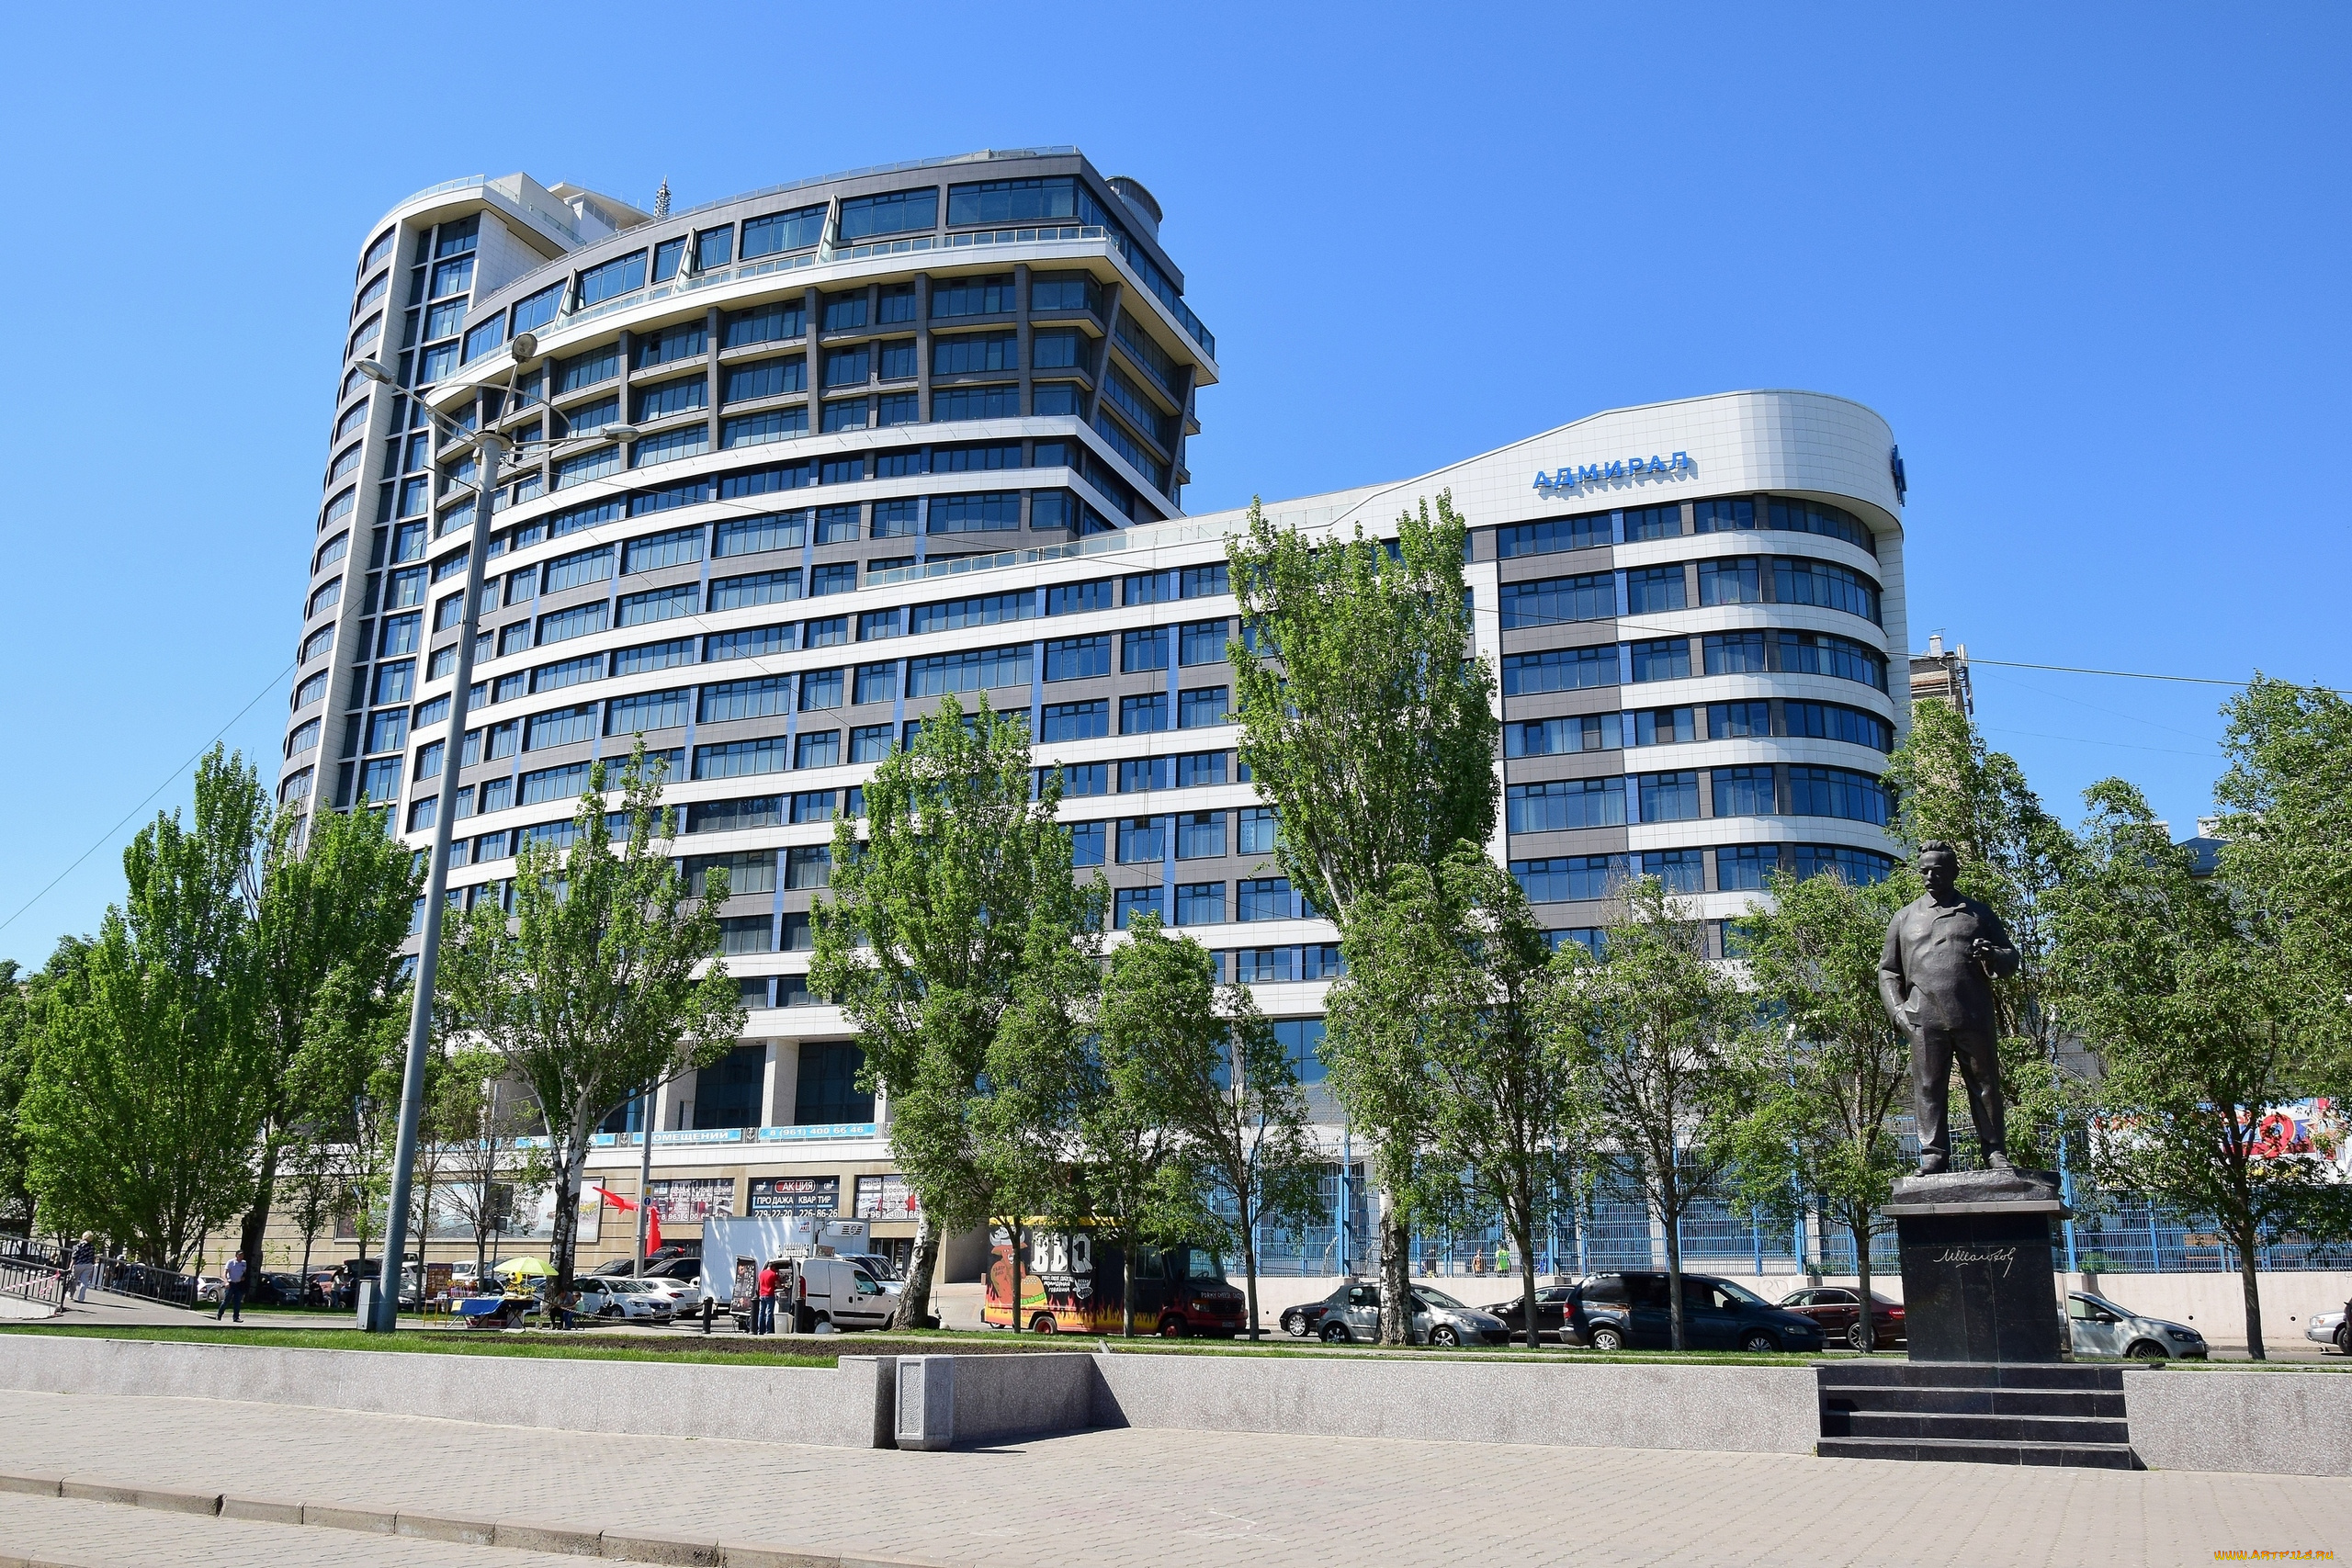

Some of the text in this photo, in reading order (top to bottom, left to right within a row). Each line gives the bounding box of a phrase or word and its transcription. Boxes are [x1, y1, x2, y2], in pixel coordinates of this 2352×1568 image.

[1532, 450, 1689, 490] АДМИРАЛ
[653, 1130, 729, 1142] ОМЕЩЕНИЙ
[779, 1128, 807, 1137] (961)
[782, 1181, 813, 1192] АКЦИЯ
[756, 1195, 831, 1205] ПРОДАЖА КВАРТИР
[754, 1209, 838, 1218] 279-22-20 226-86-26
[1031, 1231, 1093, 1274] BBQ
